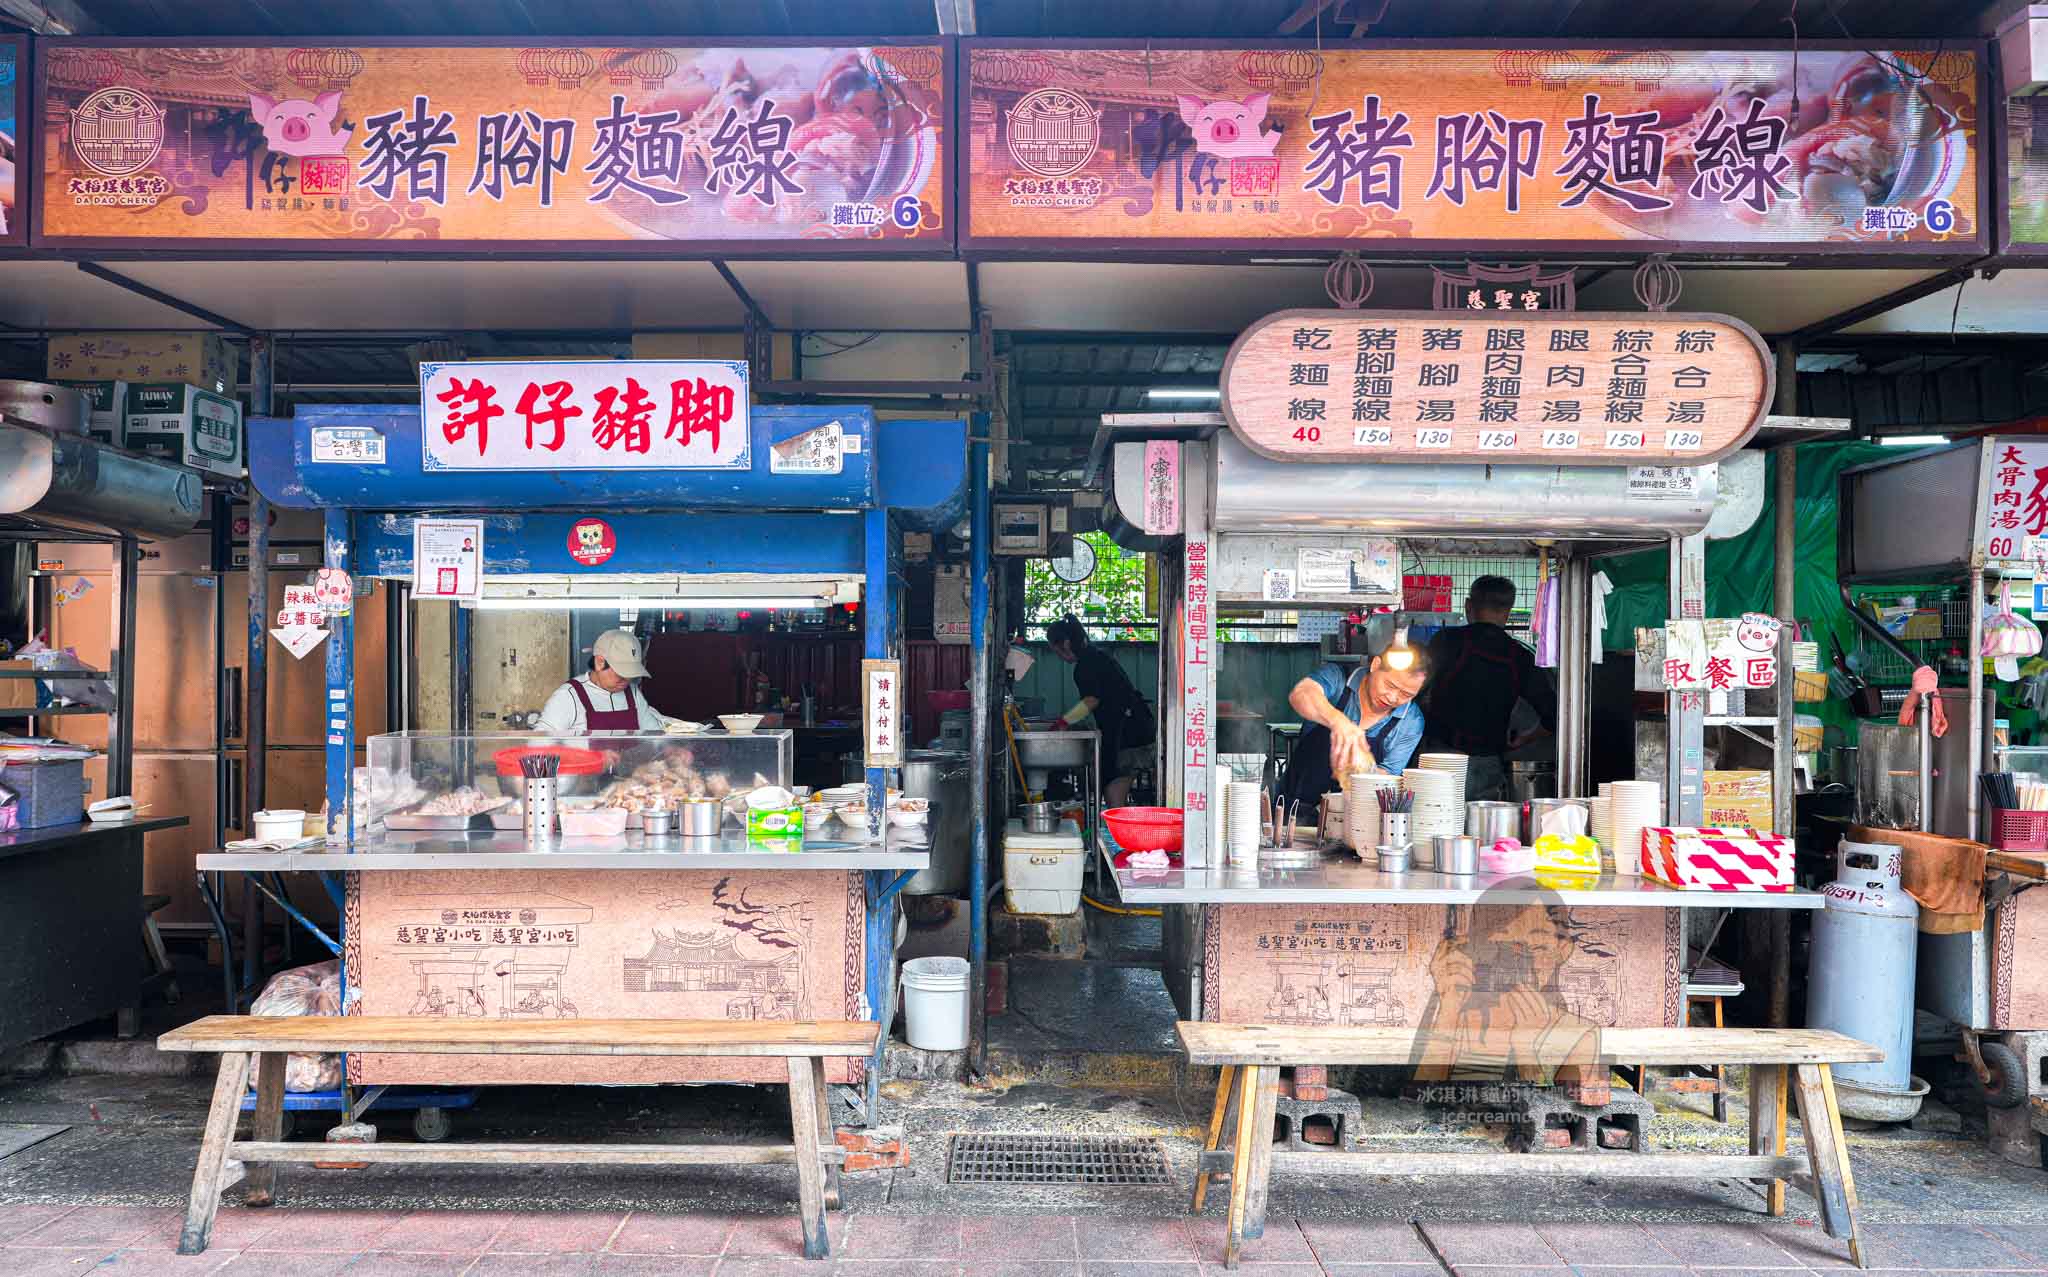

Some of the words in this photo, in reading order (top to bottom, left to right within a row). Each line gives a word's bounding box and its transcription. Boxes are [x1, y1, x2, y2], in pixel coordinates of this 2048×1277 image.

[359, 96, 804, 206] 豬腳麵線
[1303, 95, 1803, 212] 豬腳麵線
[70, 179, 166, 193] 大稻埕慈聖宮
[1005, 180, 1101, 195] 大稻埕慈聖宮
[894, 196, 920, 227] 6
[1926, 200, 1951, 232] 6
[1467, 289, 1541, 310] 慈聖宮
[1288, 328, 1332, 421] 乾麵線
[1352, 328, 1397, 421] 豬腳麵線
[1416, 328, 1462, 421] 豬腳湯
[1479, 329, 1526, 423] 腿肉麵線
[1542, 329, 1589, 423] 腿肉湯
[1604, 330, 1654, 423] 綜合麵線
[1665, 330, 1716, 424] 綜合湯
[138, 391, 175, 401] TAIWAN
[1293, 427, 1320, 441] 40
[1359, 430, 1388, 443] 150
[1420, 431, 1449, 443] 130
[1483, 433, 1514, 446] 150
[1547, 432, 1575, 445] 130
[1609, 434, 1639, 446] 150
[1671, 433, 1699, 445] 130
[1991, 445, 2028, 529] 大骨肉湯
[1990, 537, 2012, 557] 60
[1187, 541, 1208, 664] 營業時間早上
[1663, 655, 1776, 689] 取餐區
[877, 678, 891, 746] 請先付款
[396, 927, 482, 944] 慈聖宮小吃
[492, 928, 575, 944] 慈聖宮小吃
[1257, 935, 1328, 949] 慈聖宮小吃
[1335, 936, 1403, 950] 慈聖宮小吃
